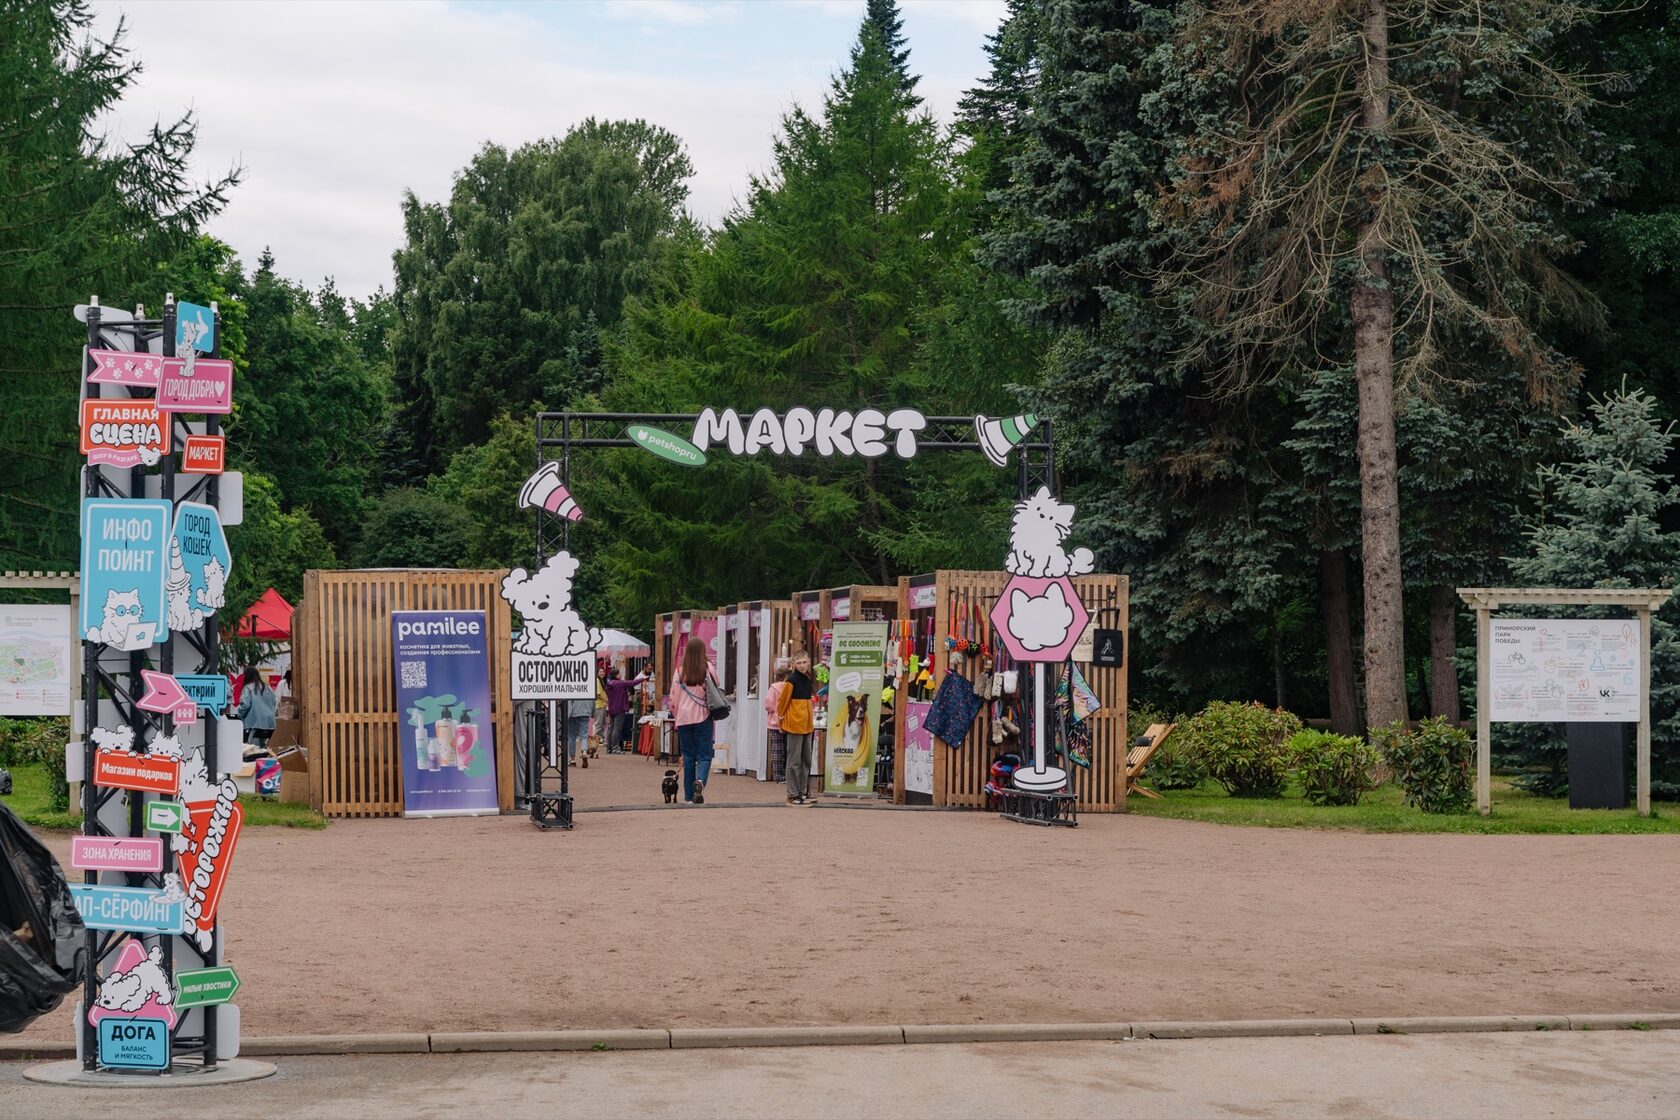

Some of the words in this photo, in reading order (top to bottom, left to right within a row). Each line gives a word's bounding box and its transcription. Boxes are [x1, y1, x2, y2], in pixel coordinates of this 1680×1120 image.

[164, 379, 188, 400] ГОРОД
[189, 380, 215, 401] ДОБРА
[93, 408, 159, 420] ГЛАВНАЯ
[89, 422, 162, 447] СЦЕНА
[691, 406, 927, 459] МАРКЕТ
[189, 446, 219, 461] МАРКЕТ
[648, 435, 697, 460] petshopru
[103, 518, 152, 541] ИНФО
[184, 513, 211, 538] ГОРОД
[183, 535, 212, 556] КОШЕК
[398, 617, 480, 641] pamilee
[518, 660, 589, 683] ОСТОРОЖНО
[181, 683, 216, 702] екторий
[519, 683, 553, 693] ХОРОШИЙ
[554, 684, 588, 693] МАЛЬЧИК
[101, 763, 136, 777] Магазин
[136, 768, 173, 782] подарков
[82, 847, 107, 860] ЗОНА
[108, 847, 152, 862] ХРАНЕНИЯ
[184, 778, 239, 936] ОСТОРОЖНО
[74, 893, 172, 923] АП-СЁРФИНГ
[111, 1025, 156, 1042] ДОГА
[121, 1045, 147, 1053] БАЛАНС
